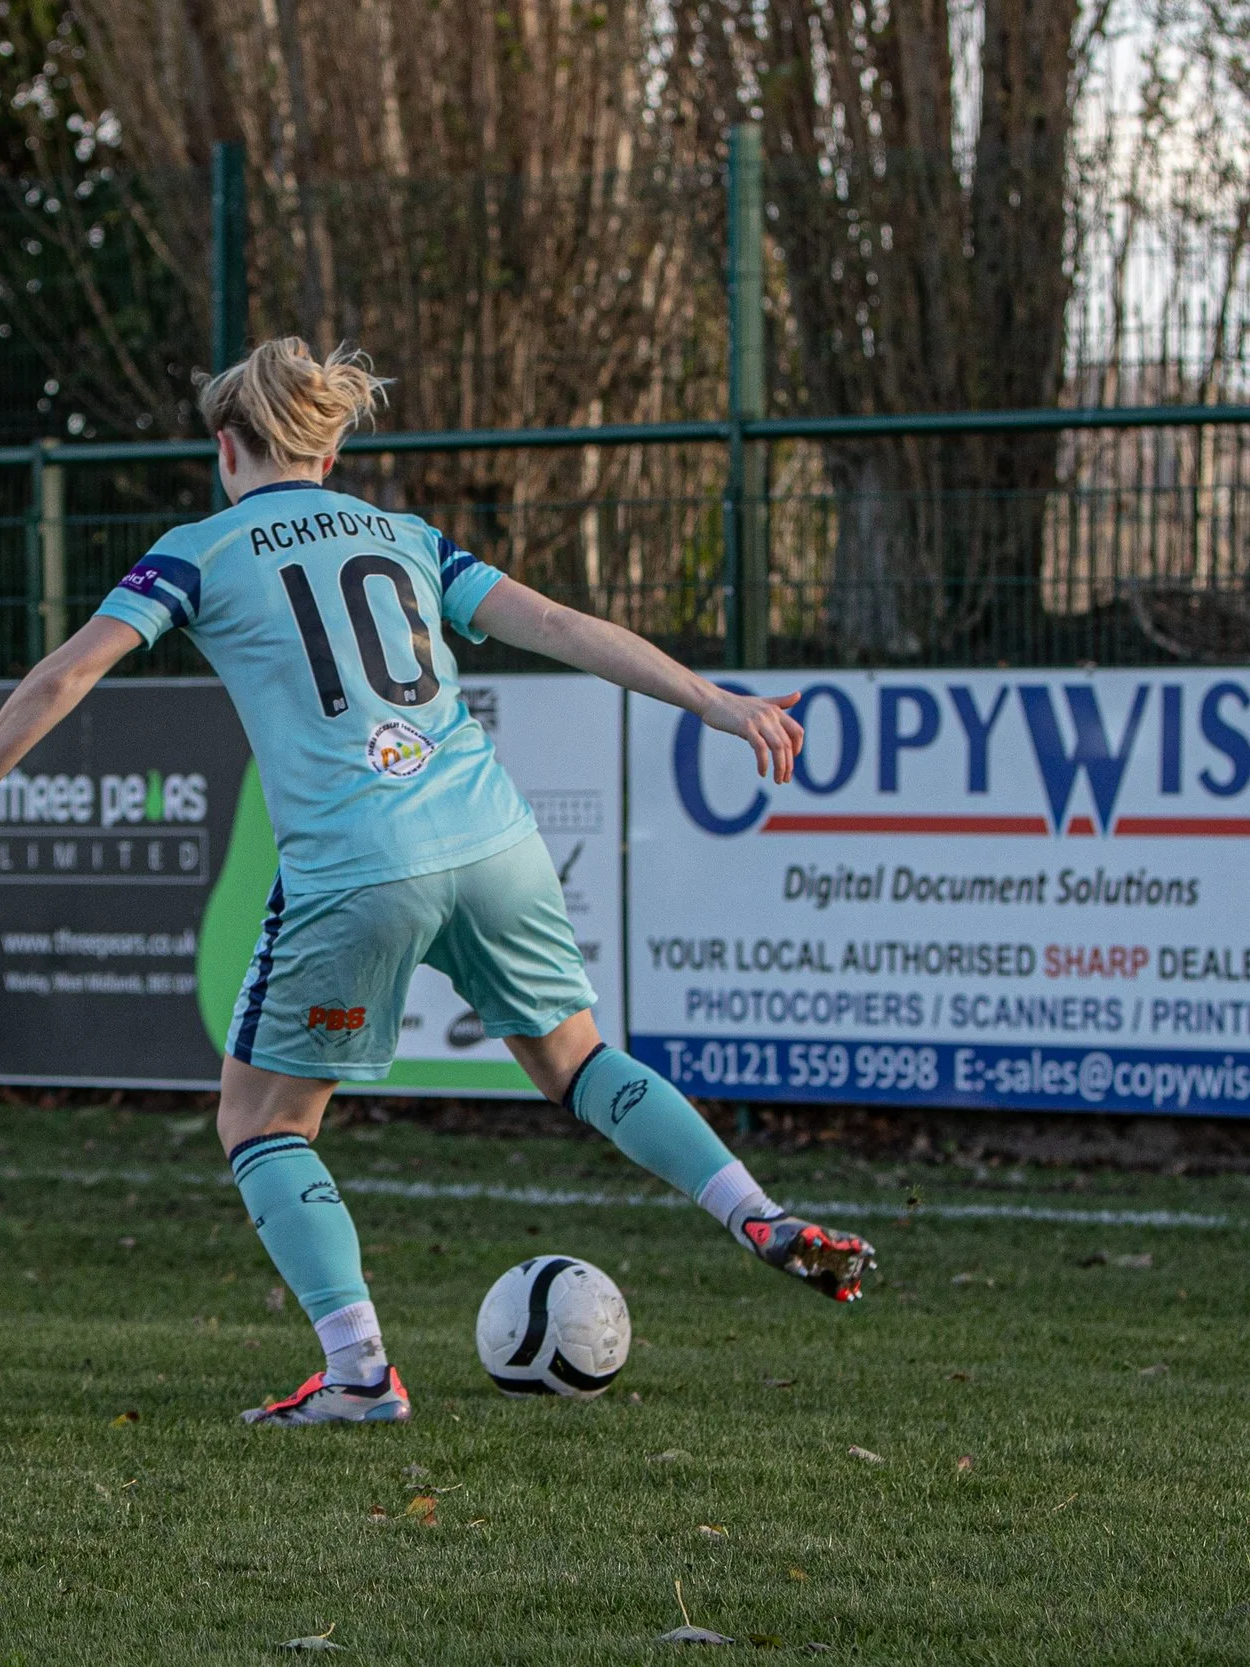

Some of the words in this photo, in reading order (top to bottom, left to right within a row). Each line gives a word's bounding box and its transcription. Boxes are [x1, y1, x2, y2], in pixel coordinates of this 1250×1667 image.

[250, 511, 396, 555] ACKROYD
[278, 553, 442, 718] 10
[784, 863, 884, 909] Digital
[892, 865, 1048, 906] Document
[1056, 866, 1201, 907] Solutions
[646, 937, 727, 972] YOUR
[735, 938, 834, 973] LOCAL
[841, 940, 1036, 977] AUTHORISED
[1044, 944, 1149, 979] SHARP
[308, 1006, 367, 1031] PBS
[685, 987, 924, 1027] PHOTOCOPIERS
[950, 993, 1124, 1032] SCANNERS
[1152, 997, 1250, 1035] PRINT
[788, 1043, 849, 1088] 559
[855, 1046, 939, 1092] 9998
